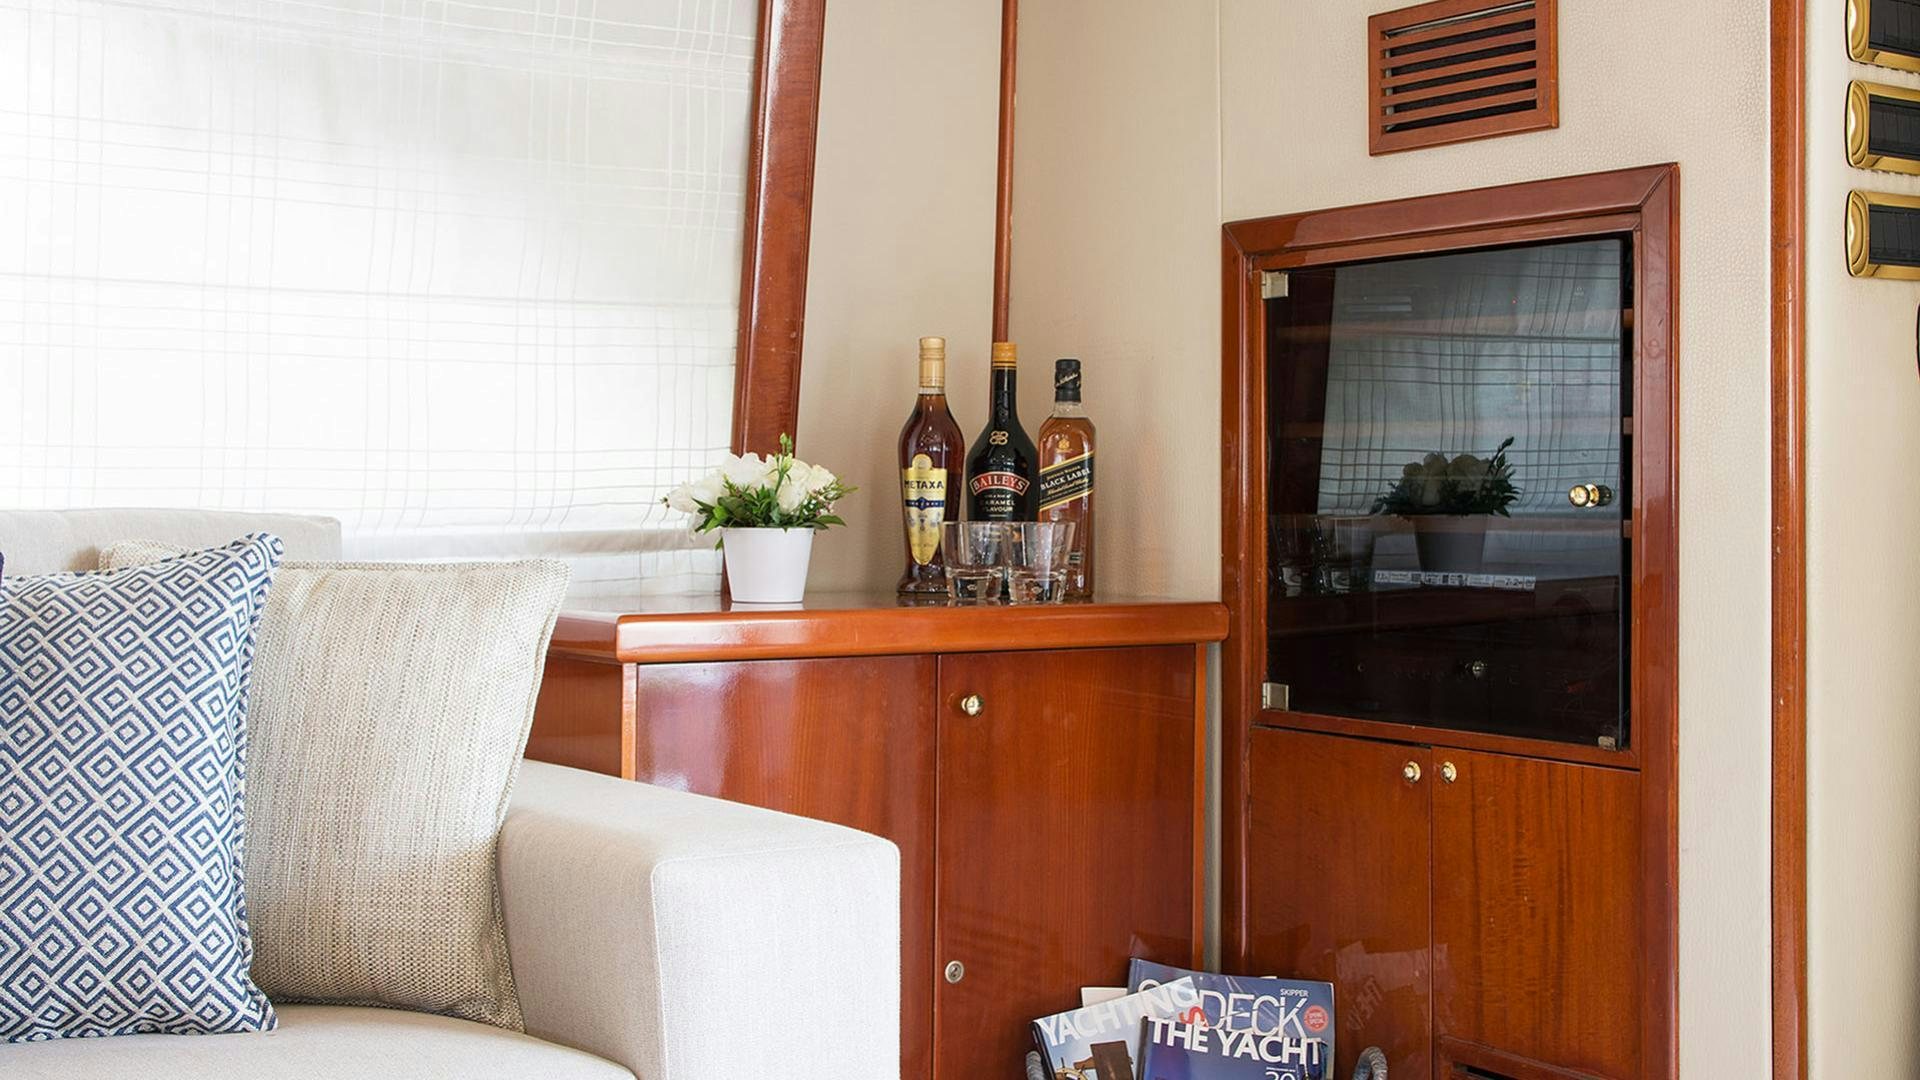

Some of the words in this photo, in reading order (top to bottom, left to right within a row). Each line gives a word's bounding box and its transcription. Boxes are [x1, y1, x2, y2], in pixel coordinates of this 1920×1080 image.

[903, 480, 944, 489] METAXA
[973, 475, 1026, 495] BAILEYS
[1040, 476, 1067, 490] BLACK
[1066, 467, 1091, 481] LABEL
[1279, 987, 1310, 998] SKIPPER
[1038, 976, 1201, 1047] YACHTING
[1198, 988, 1308, 1039] DECK
[1146, 1016, 1209, 1053] THE
[1215, 1029, 1324, 1065] YACHT
